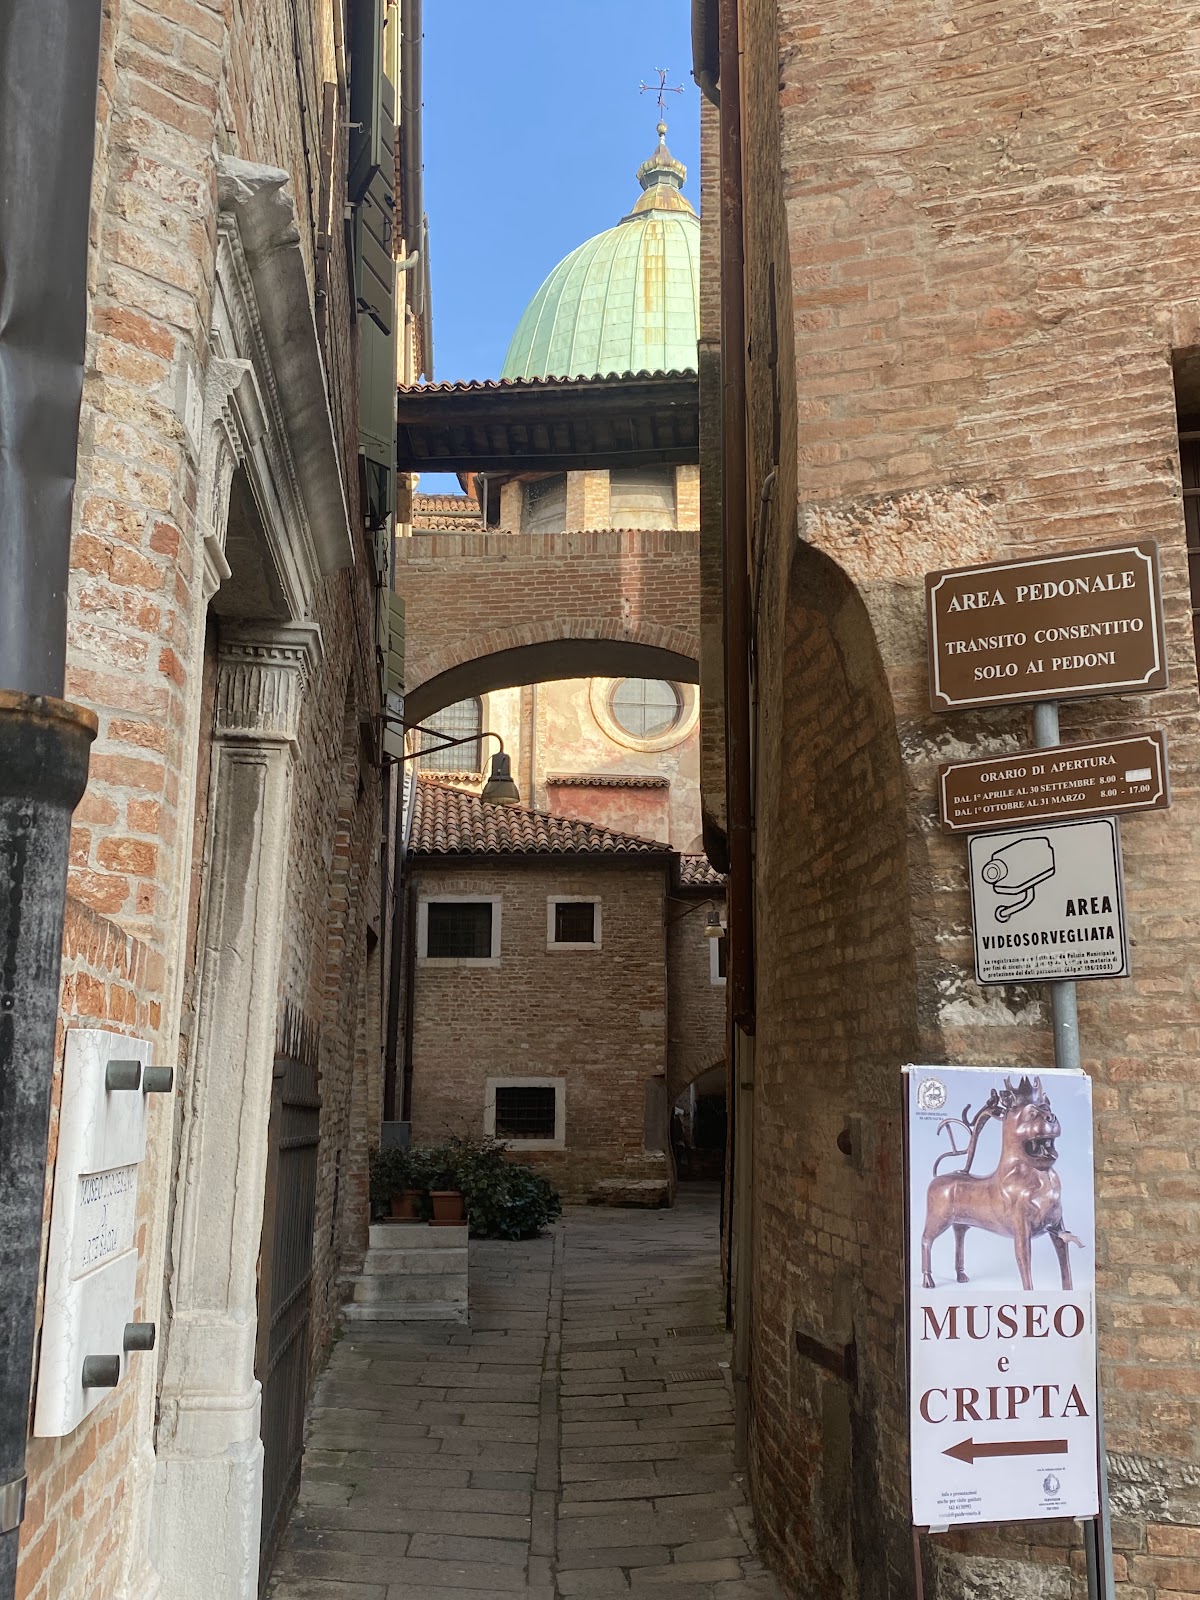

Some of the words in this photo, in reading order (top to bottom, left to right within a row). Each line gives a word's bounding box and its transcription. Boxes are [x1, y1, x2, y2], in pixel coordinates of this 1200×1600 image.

[947, 588, 1006, 613] AREA
[1015, 571, 1136, 603] PEDONALE
[945, 632, 1027, 655] TRANSITO
[1034, 618, 1144, 644] CONSENTITO
[973, 663, 1018, 681] SOLO
[1025, 660, 1044, 674] AI
[1051, 651, 1116, 672] PEDONI
[980, 768, 1026, 782] ORARIO
[1032, 765, 1045, 775] DI
[1050, 755, 1117, 773] APERTURA
[954, 795, 971, 804] DAL
[982, 789, 1014, 800] APRILE
[1016, 787, 1028, 796] AL
[1030, 785, 1039, 794] 30
[1040, 778, 1096, 792] SETTEMBRE
[1099, 775, 1116, 785] 8.00
[954, 808, 972, 817] DAL
[983, 801, 1025, 813] OTTOBRE
[1027, 799, 1039, 807] AL
[1040, 797, 1049, 806] 31
[1051, 792, 1086, 805] MARZO
[1100, 789, 1117, 797] 8.00
[1129, 784, 1150, 794] 17.00
[1065, 896, 1112, 917] AREA
[982, 925, 1115, 949] VIDEOSORVEGLIATA
[920, 1304, 1084, 1341] MUSEO
[997, 1355, 1010, 1373] e
[919, 1383, 1090, 1424] CRIPTA
